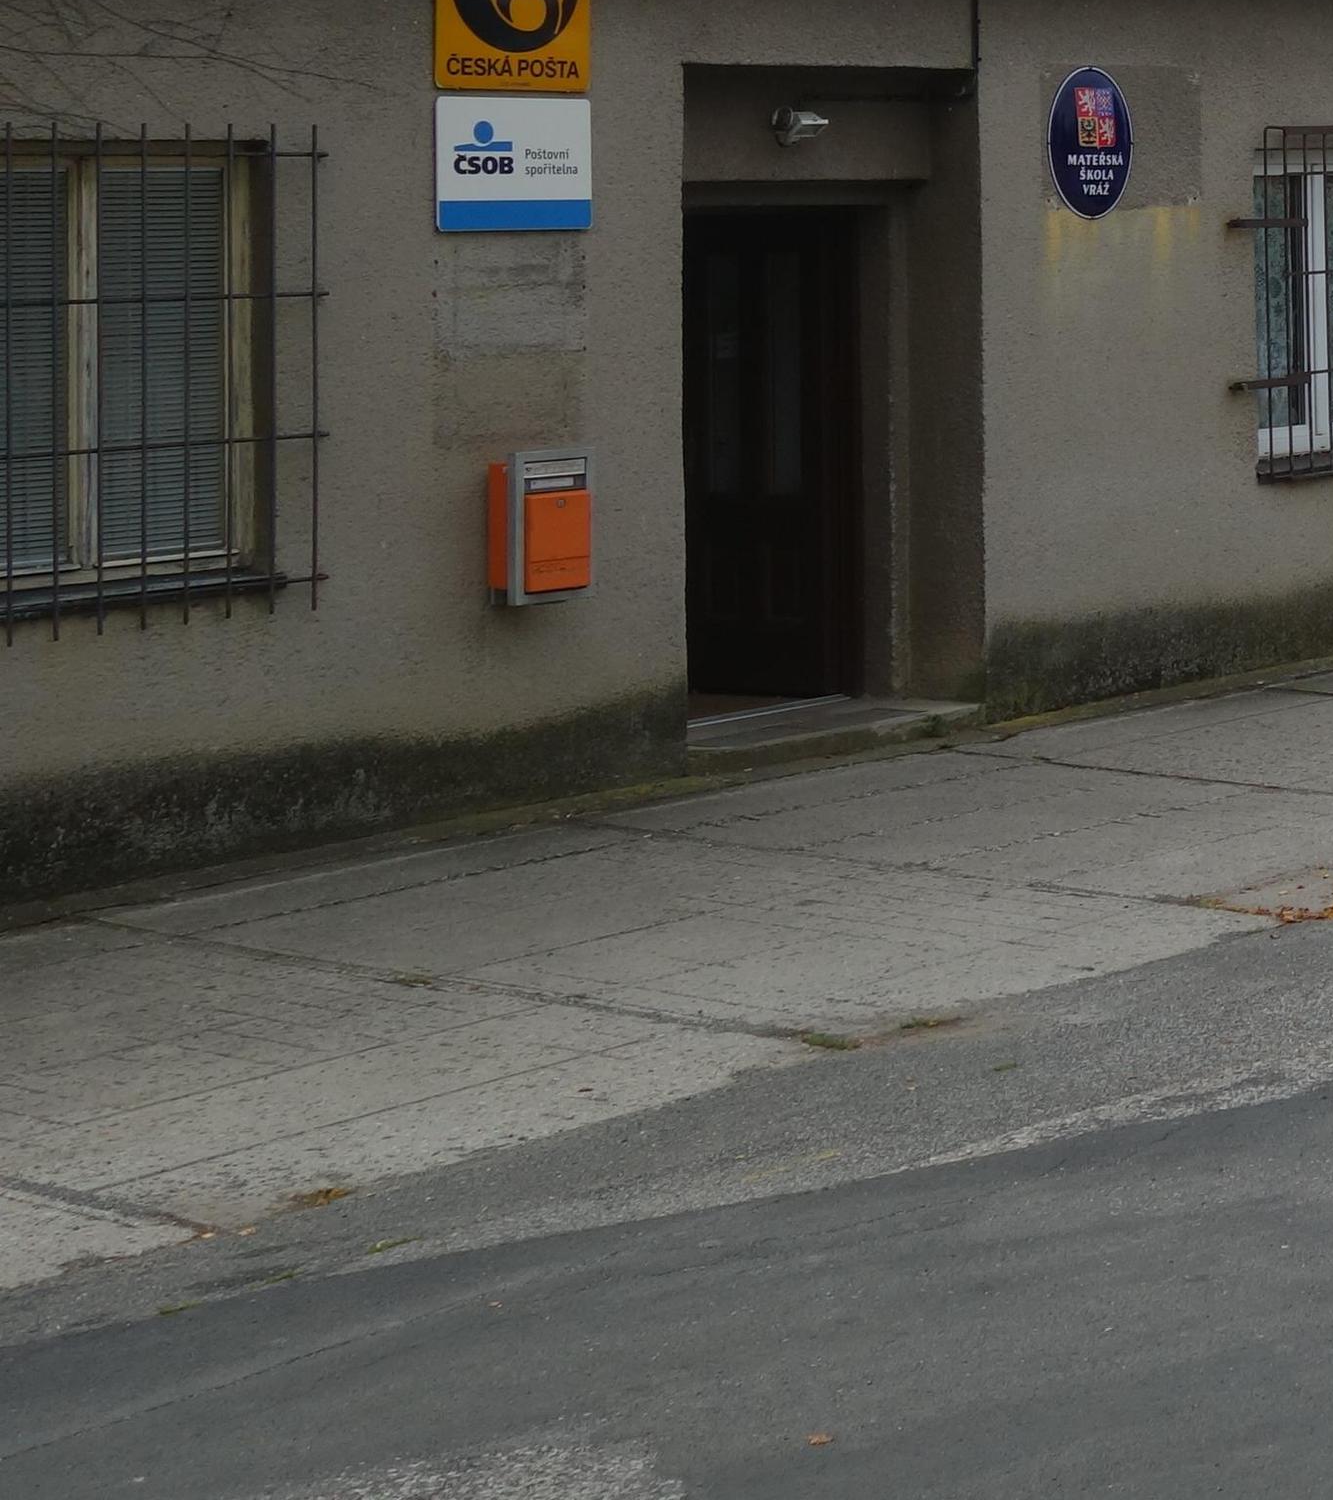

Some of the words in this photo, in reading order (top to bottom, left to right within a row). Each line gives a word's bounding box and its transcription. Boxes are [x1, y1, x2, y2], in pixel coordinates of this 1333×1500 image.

[446, 53, 513, 77] ČESKÁ
[517, 56, 580, 79] POŠTA
[525, 148, 570, 160] Poštovní
[1067, 151, 1124, 166] MATEŘSKÁ
[453, 153, 514, 175] ČSOB
[525, 164, 579, 177] spořitelna
[1079, 166, 1114, 181] ŠKOLA
[1082, 181, 1110, 196] VRÁŽ
